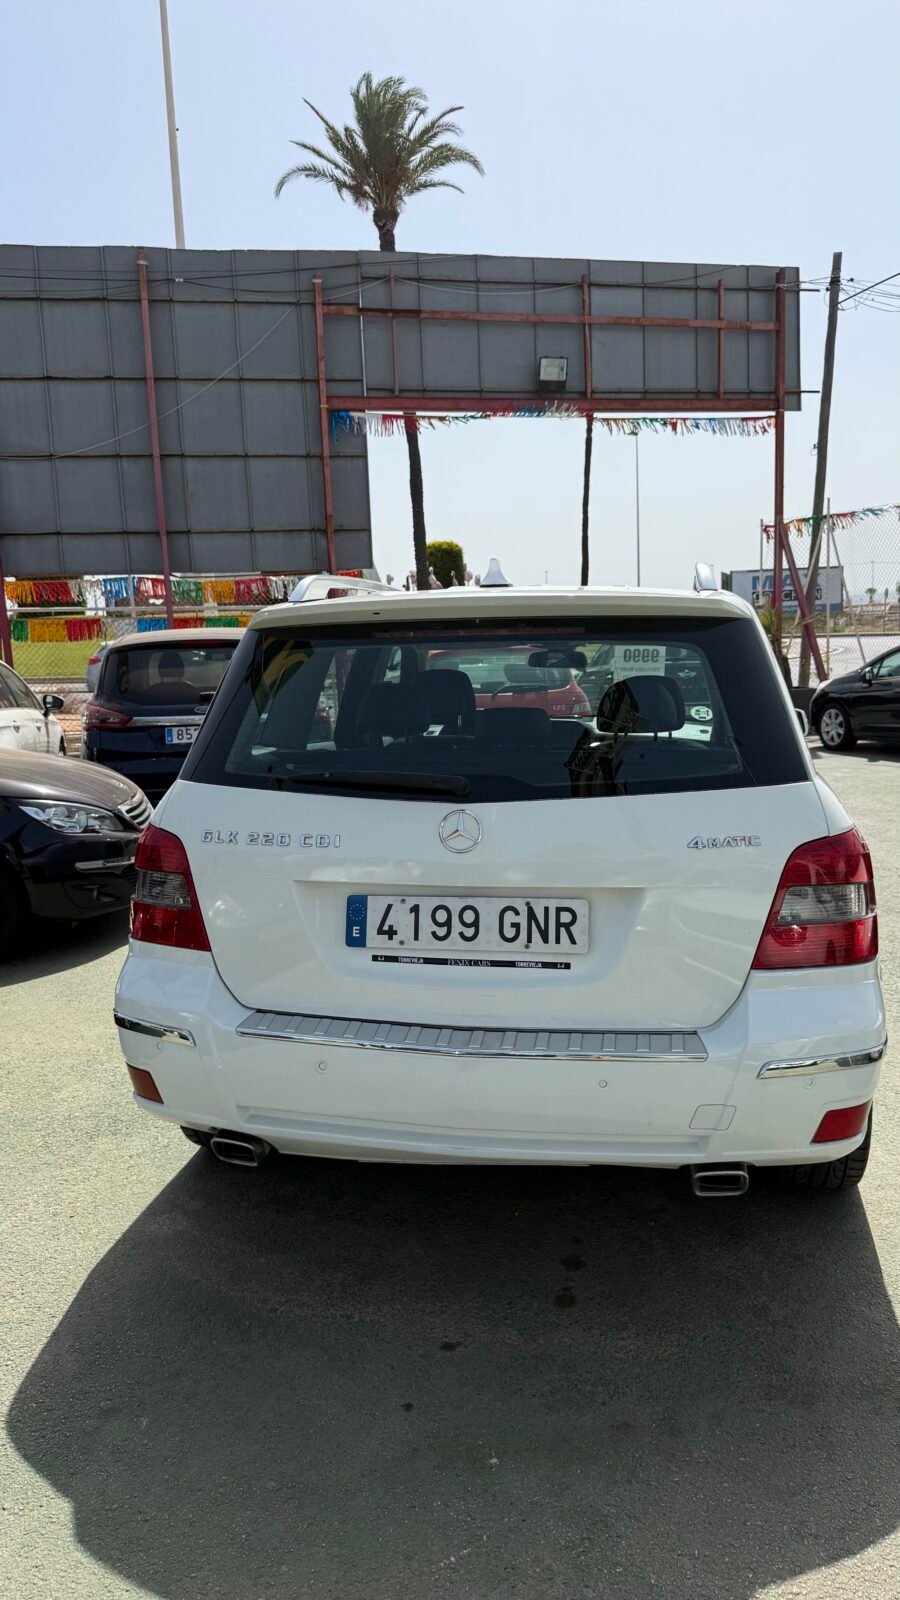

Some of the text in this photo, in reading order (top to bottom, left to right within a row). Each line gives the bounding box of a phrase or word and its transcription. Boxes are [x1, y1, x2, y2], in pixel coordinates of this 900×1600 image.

[176, 728, 199, 741] 85
[201, 830, 341, 848] GLK 220 CDI
[687, 835, 762, 850] 4MATIC
[352, 903, 578, 945] E 4199 GNR
[447, 958, 470, 967] FENIX
[471, 959, 491, 967] CARS
